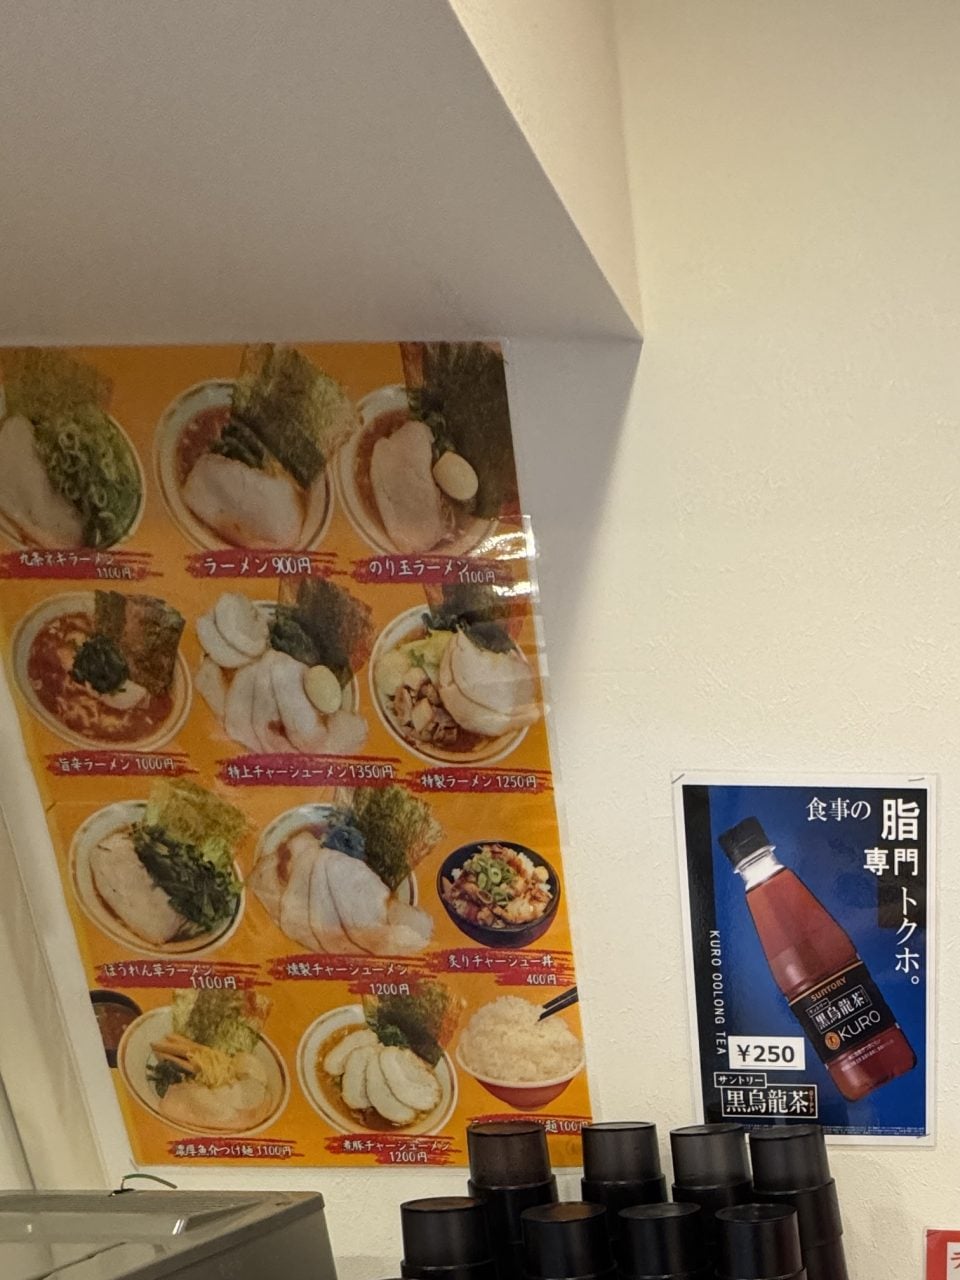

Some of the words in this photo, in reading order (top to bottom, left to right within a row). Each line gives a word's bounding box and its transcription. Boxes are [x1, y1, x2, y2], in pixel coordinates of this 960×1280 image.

[203, 558, 268, 575] ラーメン
[273, 556, 312, 575] 900円
[368, 560, 469, 576] のり玉ラーメン
[458, 571, 496, 583] 1100円
[806, 797, 872, 822] 食事の
[881, 798, 921, 842] 脂
[863, 847, 919, 877] 専門
[895, 886, 921, 986] トクホ。
[708, 930, 721, 966] KURO
[189, 976, 237, 989] 1100円
[368, 983, 410, 996] 1200円
[526, 973, 558, 986] 400円
[810, 977, 848, 1001] SUNTORY
[711, 972, 726, 1024] OOLONG
[837, 1010, 881, 1042] KURO
[715, 1032, 727, 1056] TEA
[737, 1043, 796, 1064] ¥250
[717, 1075, 764, 1085] サントリー
[726, 1089, 809, 1114] 黒烏龍茶
[389, 1151, 428, 1164] 1200円
